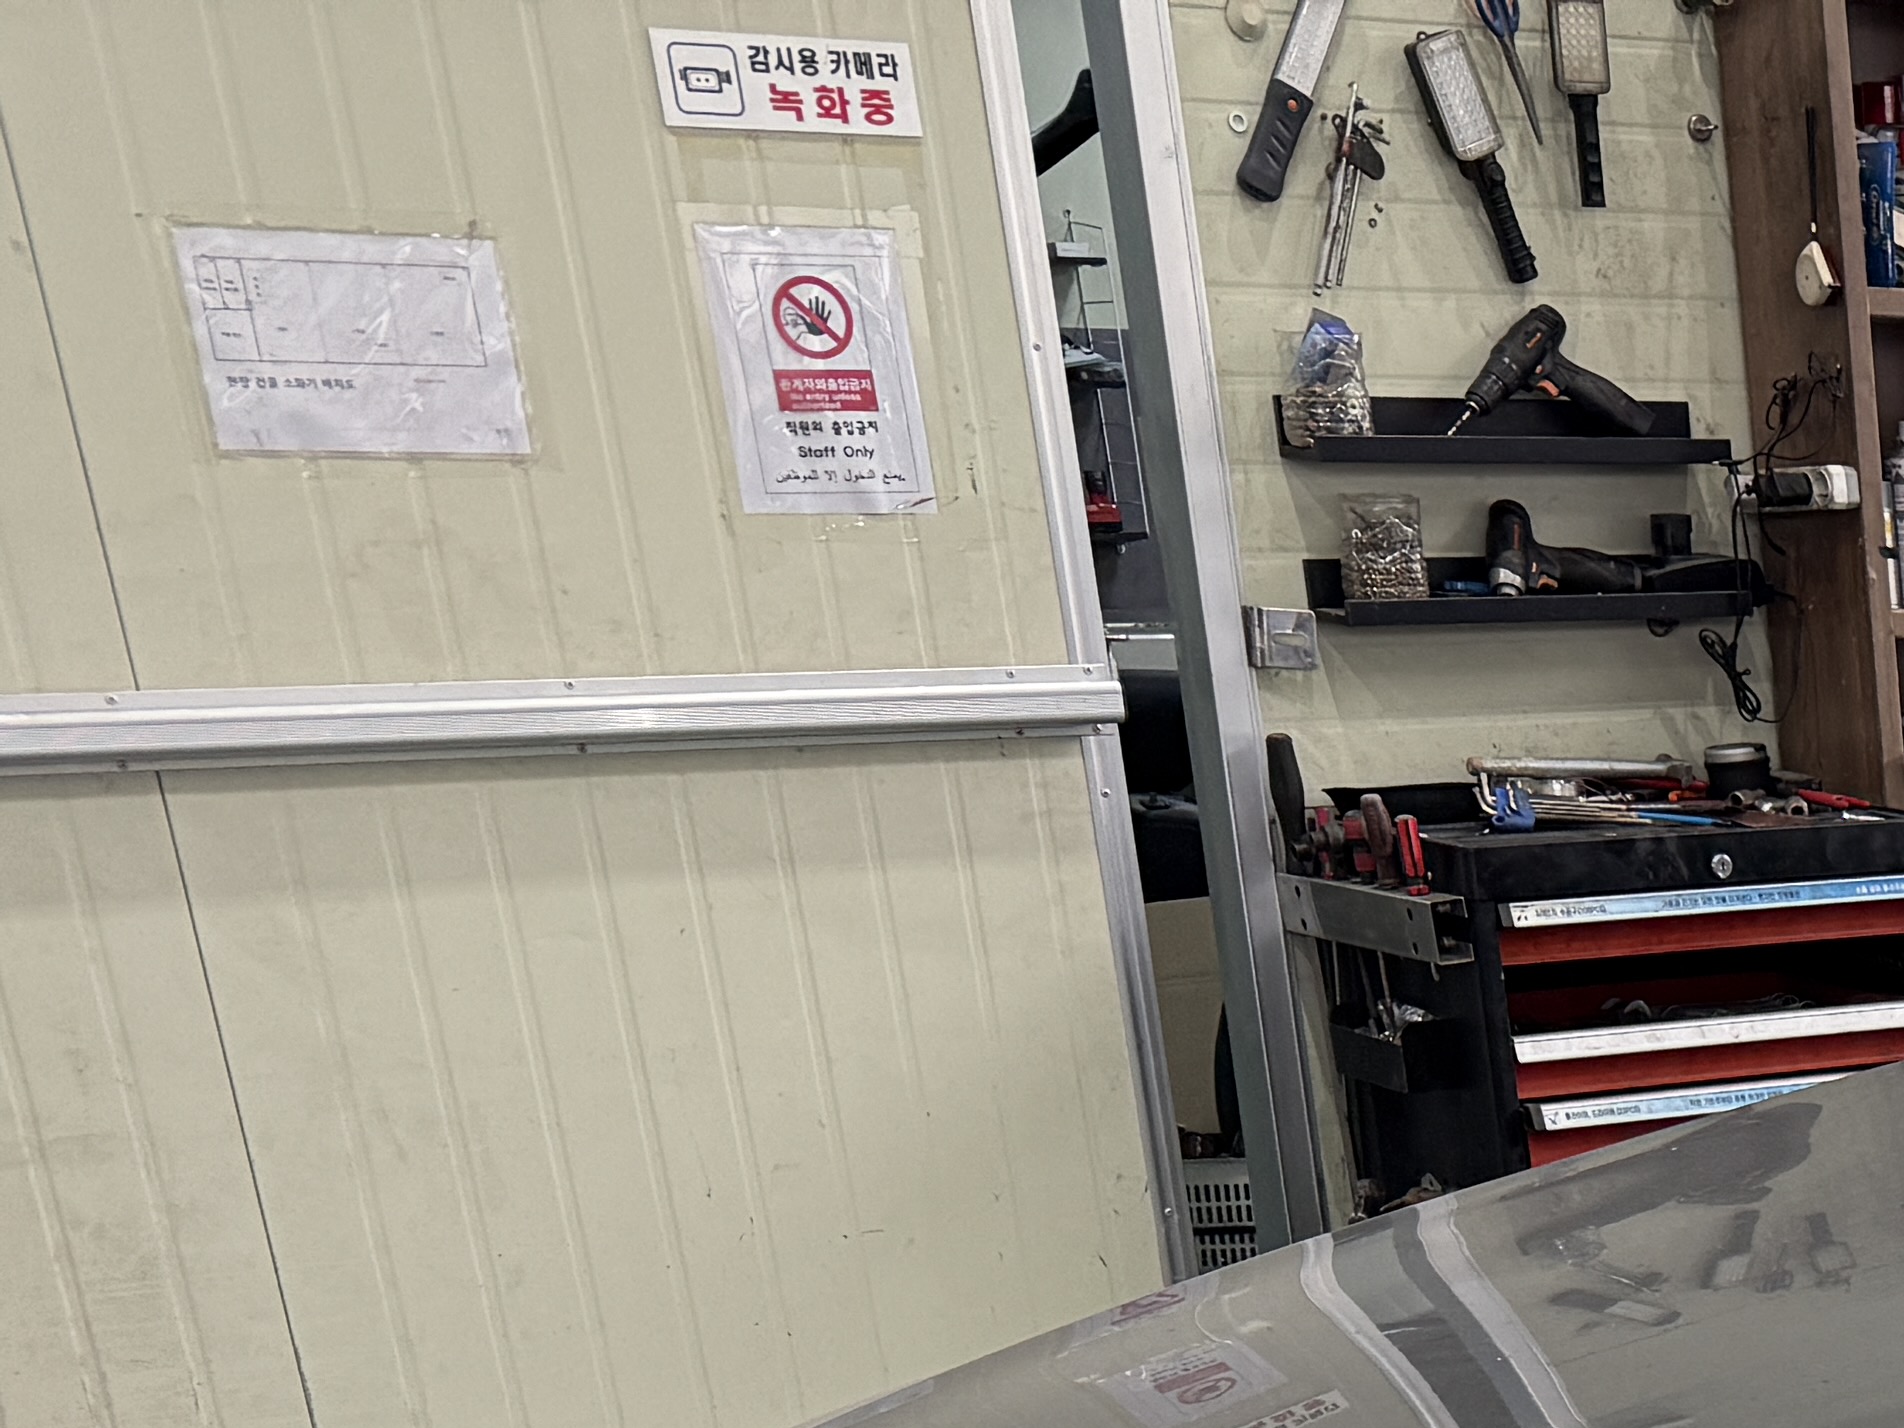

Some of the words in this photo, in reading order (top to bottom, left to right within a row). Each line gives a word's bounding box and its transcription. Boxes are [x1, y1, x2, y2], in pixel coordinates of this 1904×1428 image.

[747, 45, 820, 77] 감시용
[828, 49, 899, 82] 카메라
[768, 82, 895, 127] 녹화중
[831, 420, 879, 436] 출입금지
[797, 445, 836, 459] Staff
[843, 445, 875, 461] Only
